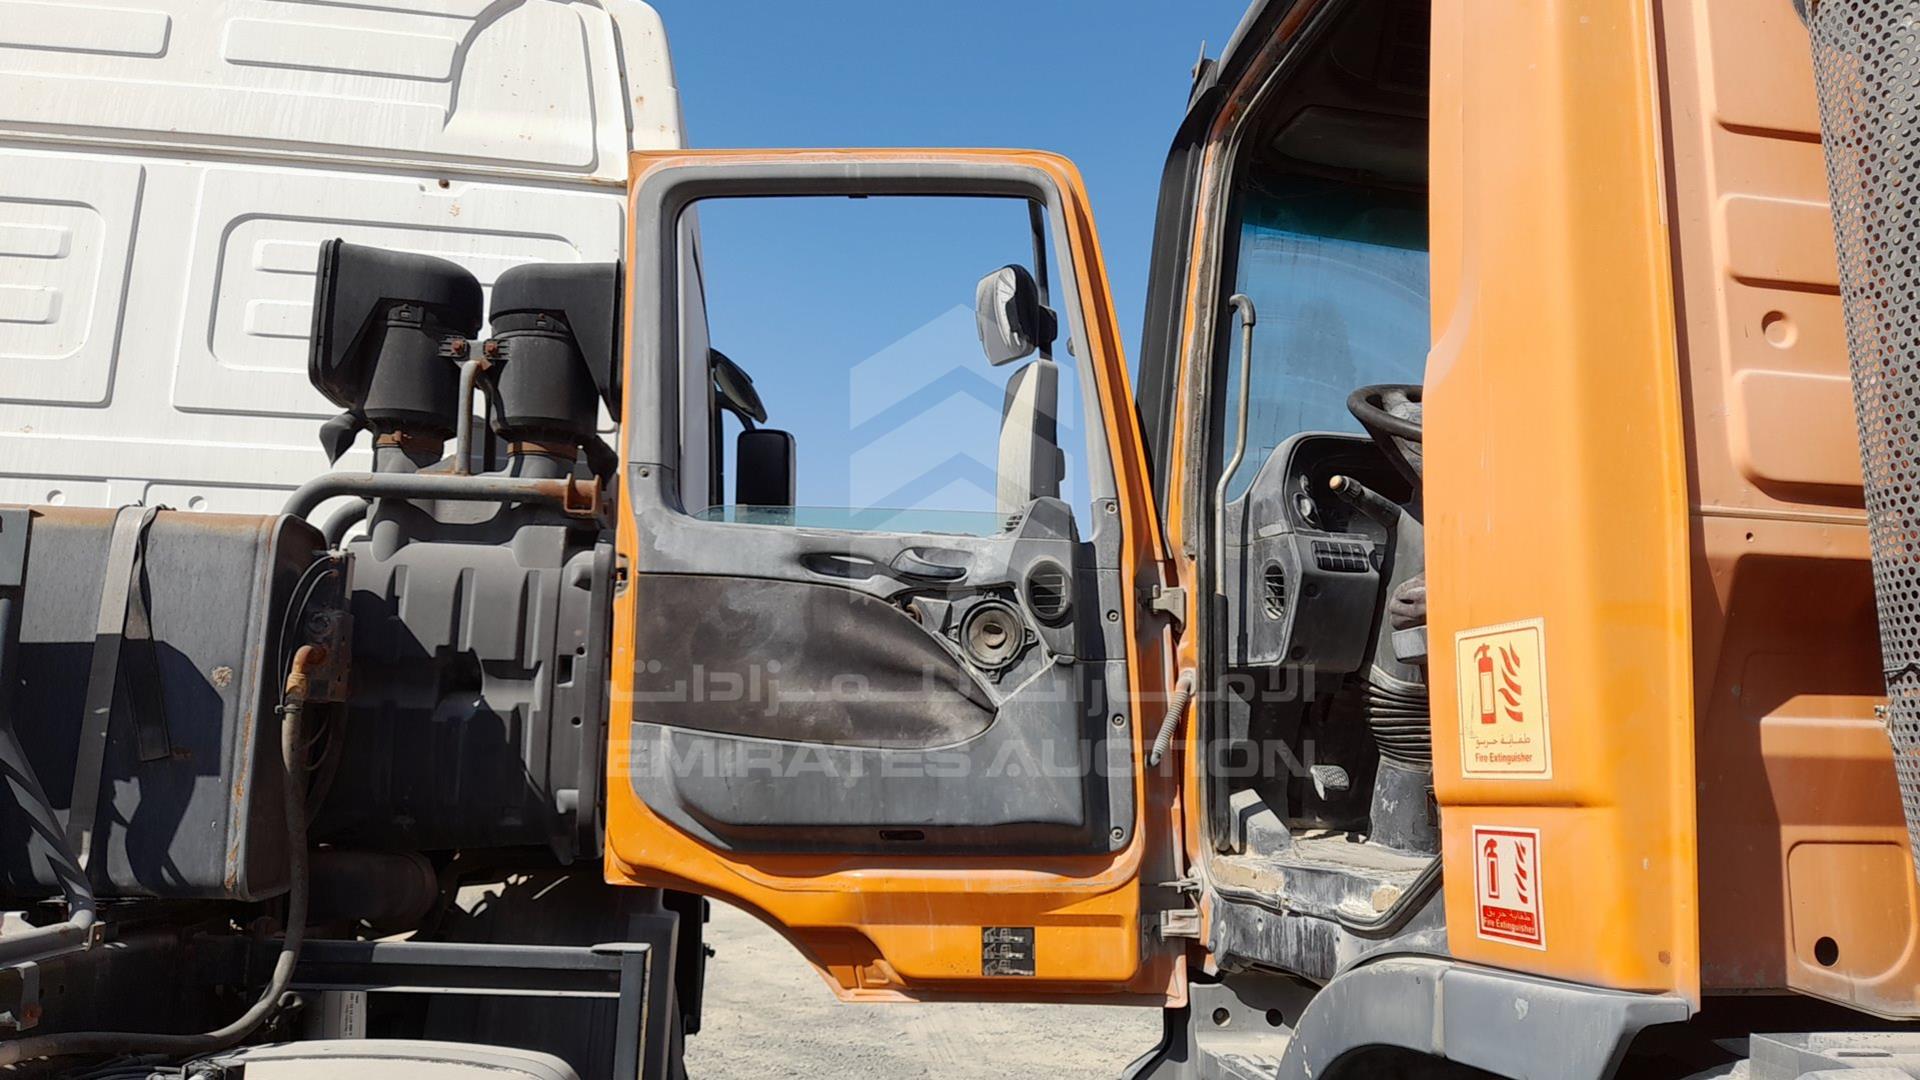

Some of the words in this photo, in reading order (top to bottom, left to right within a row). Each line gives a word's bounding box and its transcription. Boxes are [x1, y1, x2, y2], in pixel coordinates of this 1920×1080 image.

[1475, 752, 1488, 763] Fire
[1489, 752, 1533, 765] Extinguisher
[1483, 917, 1495, 927] Fire
[1495, 918, 1535, 934] Extinguisher
